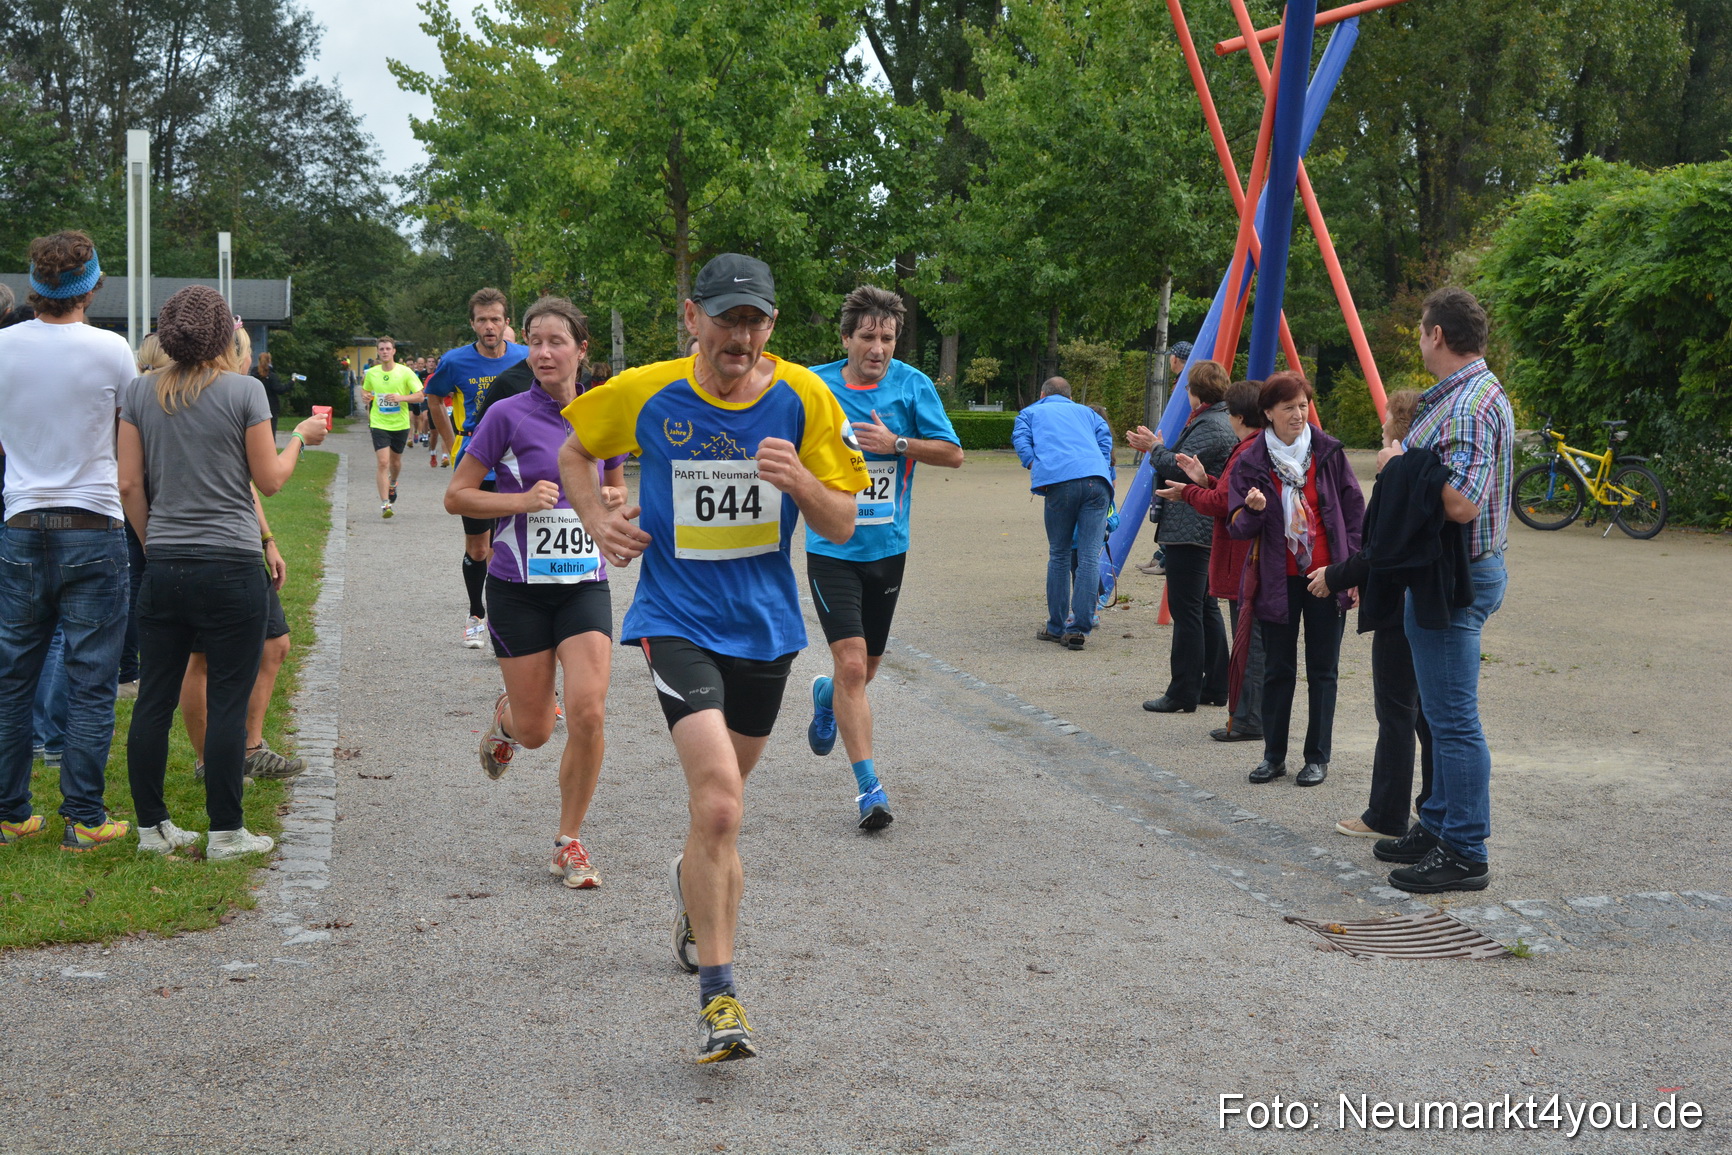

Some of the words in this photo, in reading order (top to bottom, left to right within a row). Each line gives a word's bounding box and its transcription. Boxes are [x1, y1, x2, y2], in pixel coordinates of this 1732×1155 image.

[479, 375, 497, 383] NEU
[674, 470, 710, 480] PARTL
[855, 476, 890, 500] 42
[695, 484, 763, 522] 644
[528, 516, 557, 524] PARTL
[558, 516, 580, 524] Neum
[536, 527, 594, 555] 2499
[550, 561, 585, 573] Kathrin
